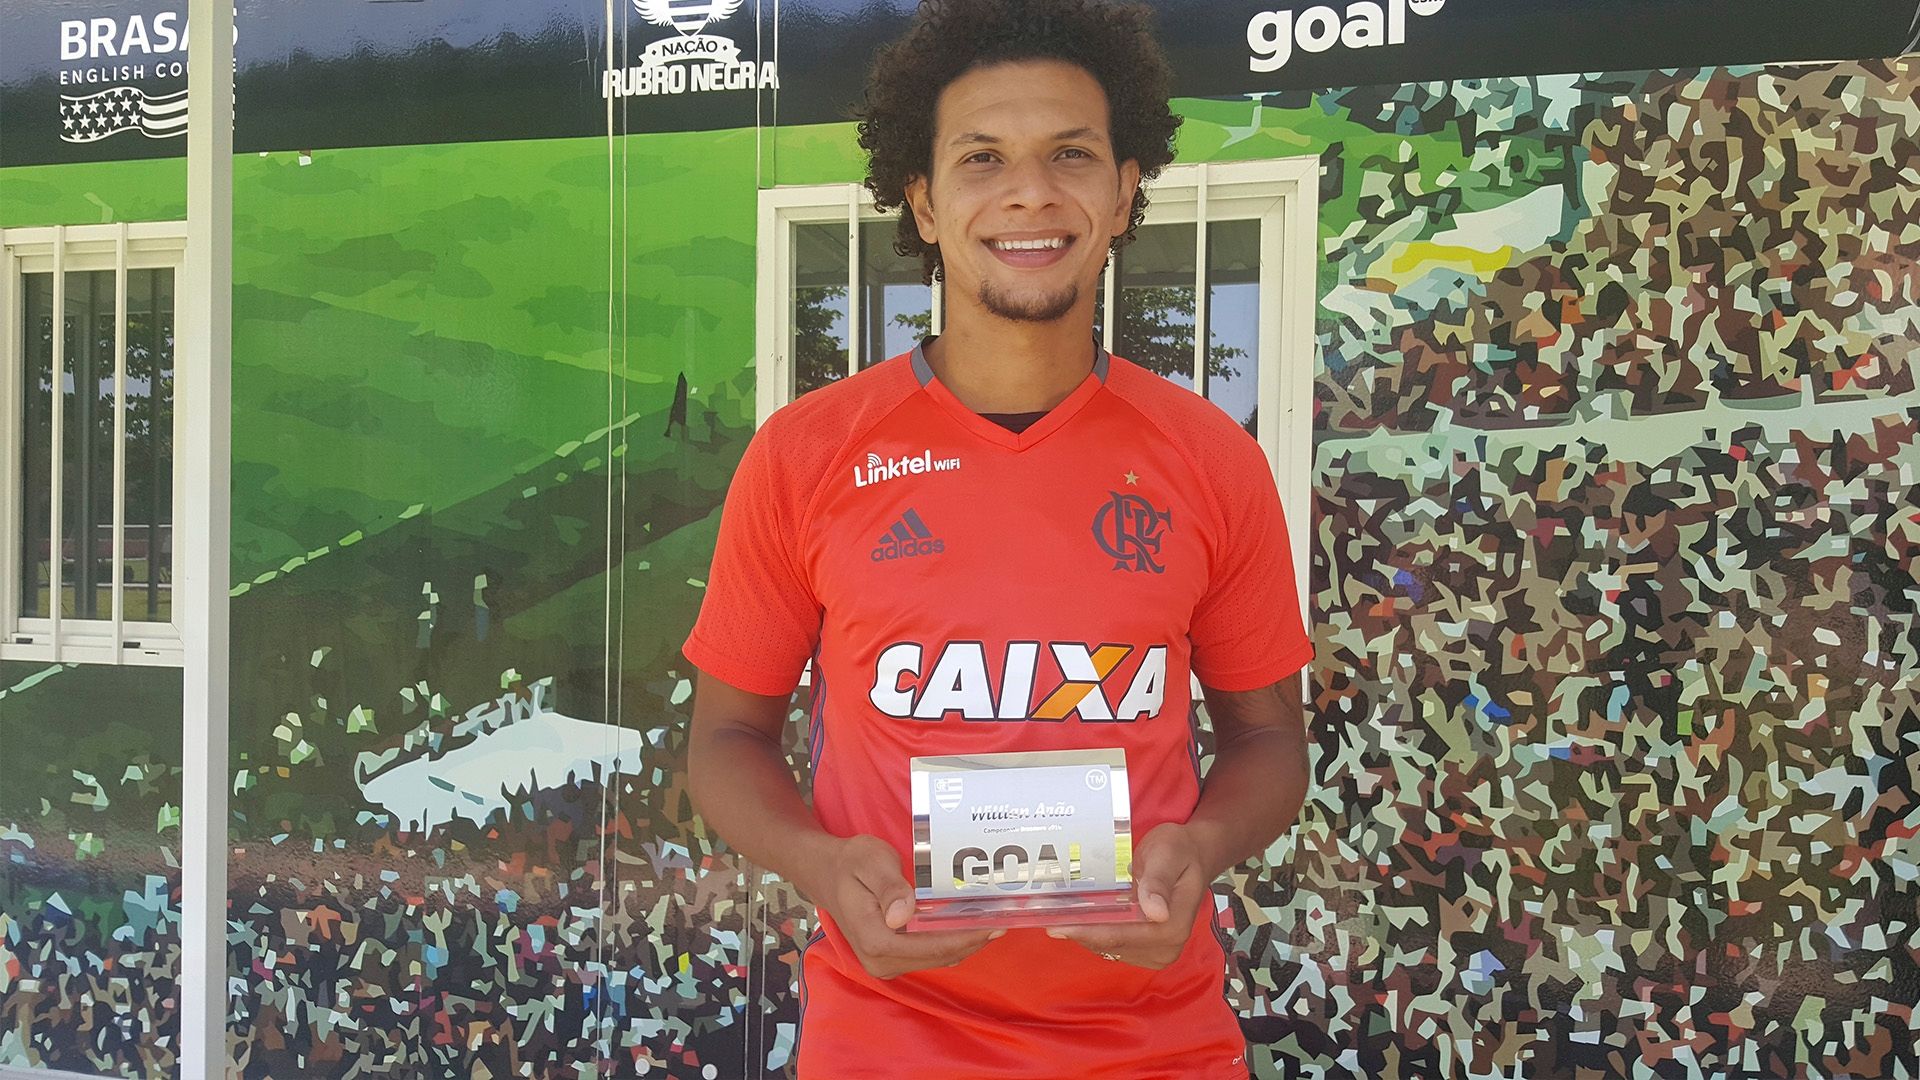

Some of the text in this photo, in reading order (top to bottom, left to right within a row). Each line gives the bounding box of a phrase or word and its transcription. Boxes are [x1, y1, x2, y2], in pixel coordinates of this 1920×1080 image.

[661, 38, 718, 57] NAÇÃO
[1246, 0, 1406, 73] goal
[60, 65, 144, 85] ENGLISH
[602, 60, 780, 99] RUBRO NEGRA
[853, 449, 932, 488] Linktel
[870, 536, 945, 562] adidas
[868, 640, 1168, 722] CAIXA
[1088, 774, 1105, 785] TM
[952, 842, 1096, 891] GOAL
